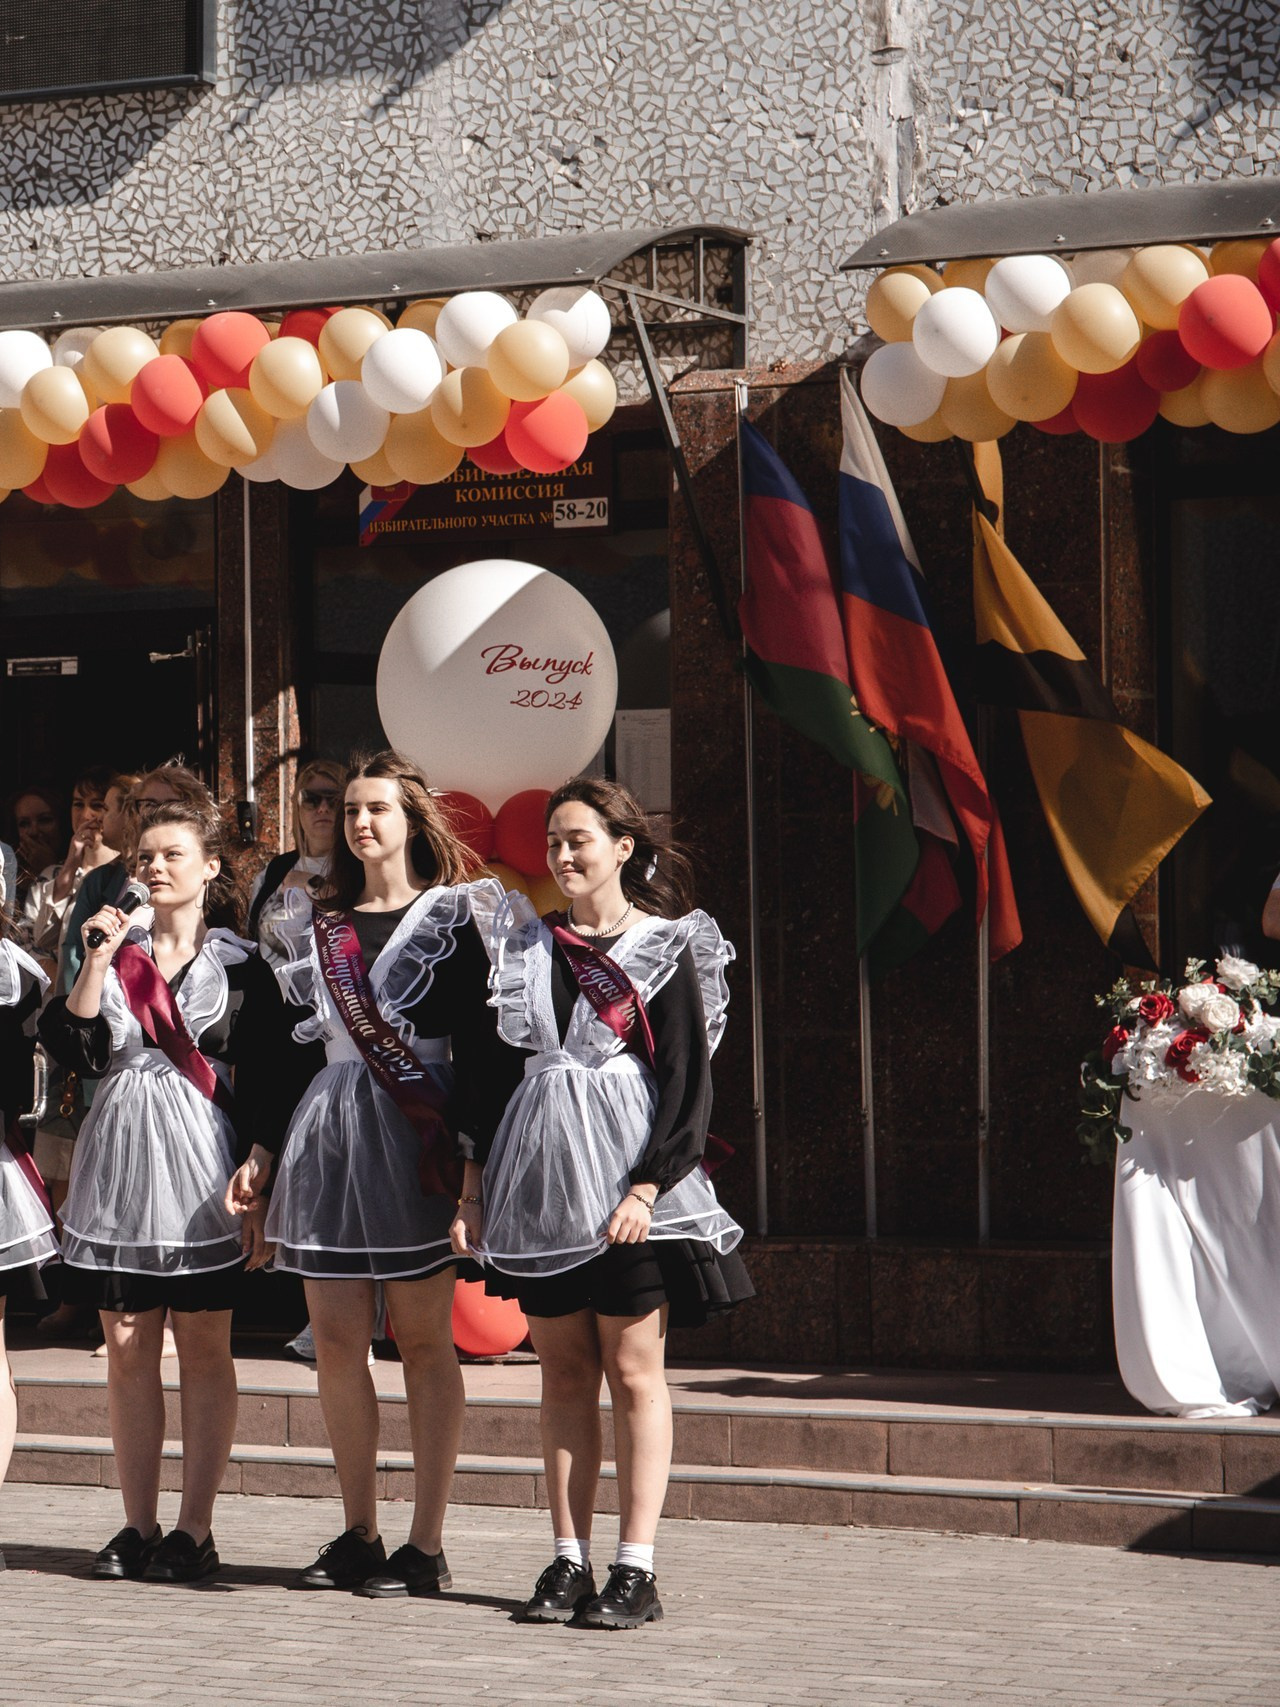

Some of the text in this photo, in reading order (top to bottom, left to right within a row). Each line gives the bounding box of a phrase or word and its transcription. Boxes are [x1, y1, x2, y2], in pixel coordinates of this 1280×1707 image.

[455, 483, 565, 503] КОМИССИЯ
[369, 513, 477, 533] ИЗБИРАТЕЛЬНОГО
[481, 511, 535, 529] УЧАСТКА
[554, 500, 608, 522] 58-20
[480, 644, 594, 684] Выпуск
[510, 689, 583, 710] 2024
[326, 923, 377, 1038] Выпускница
[371, 1036, 425, 1082] 2024
[331, 982, 341, 1002] СОШ
